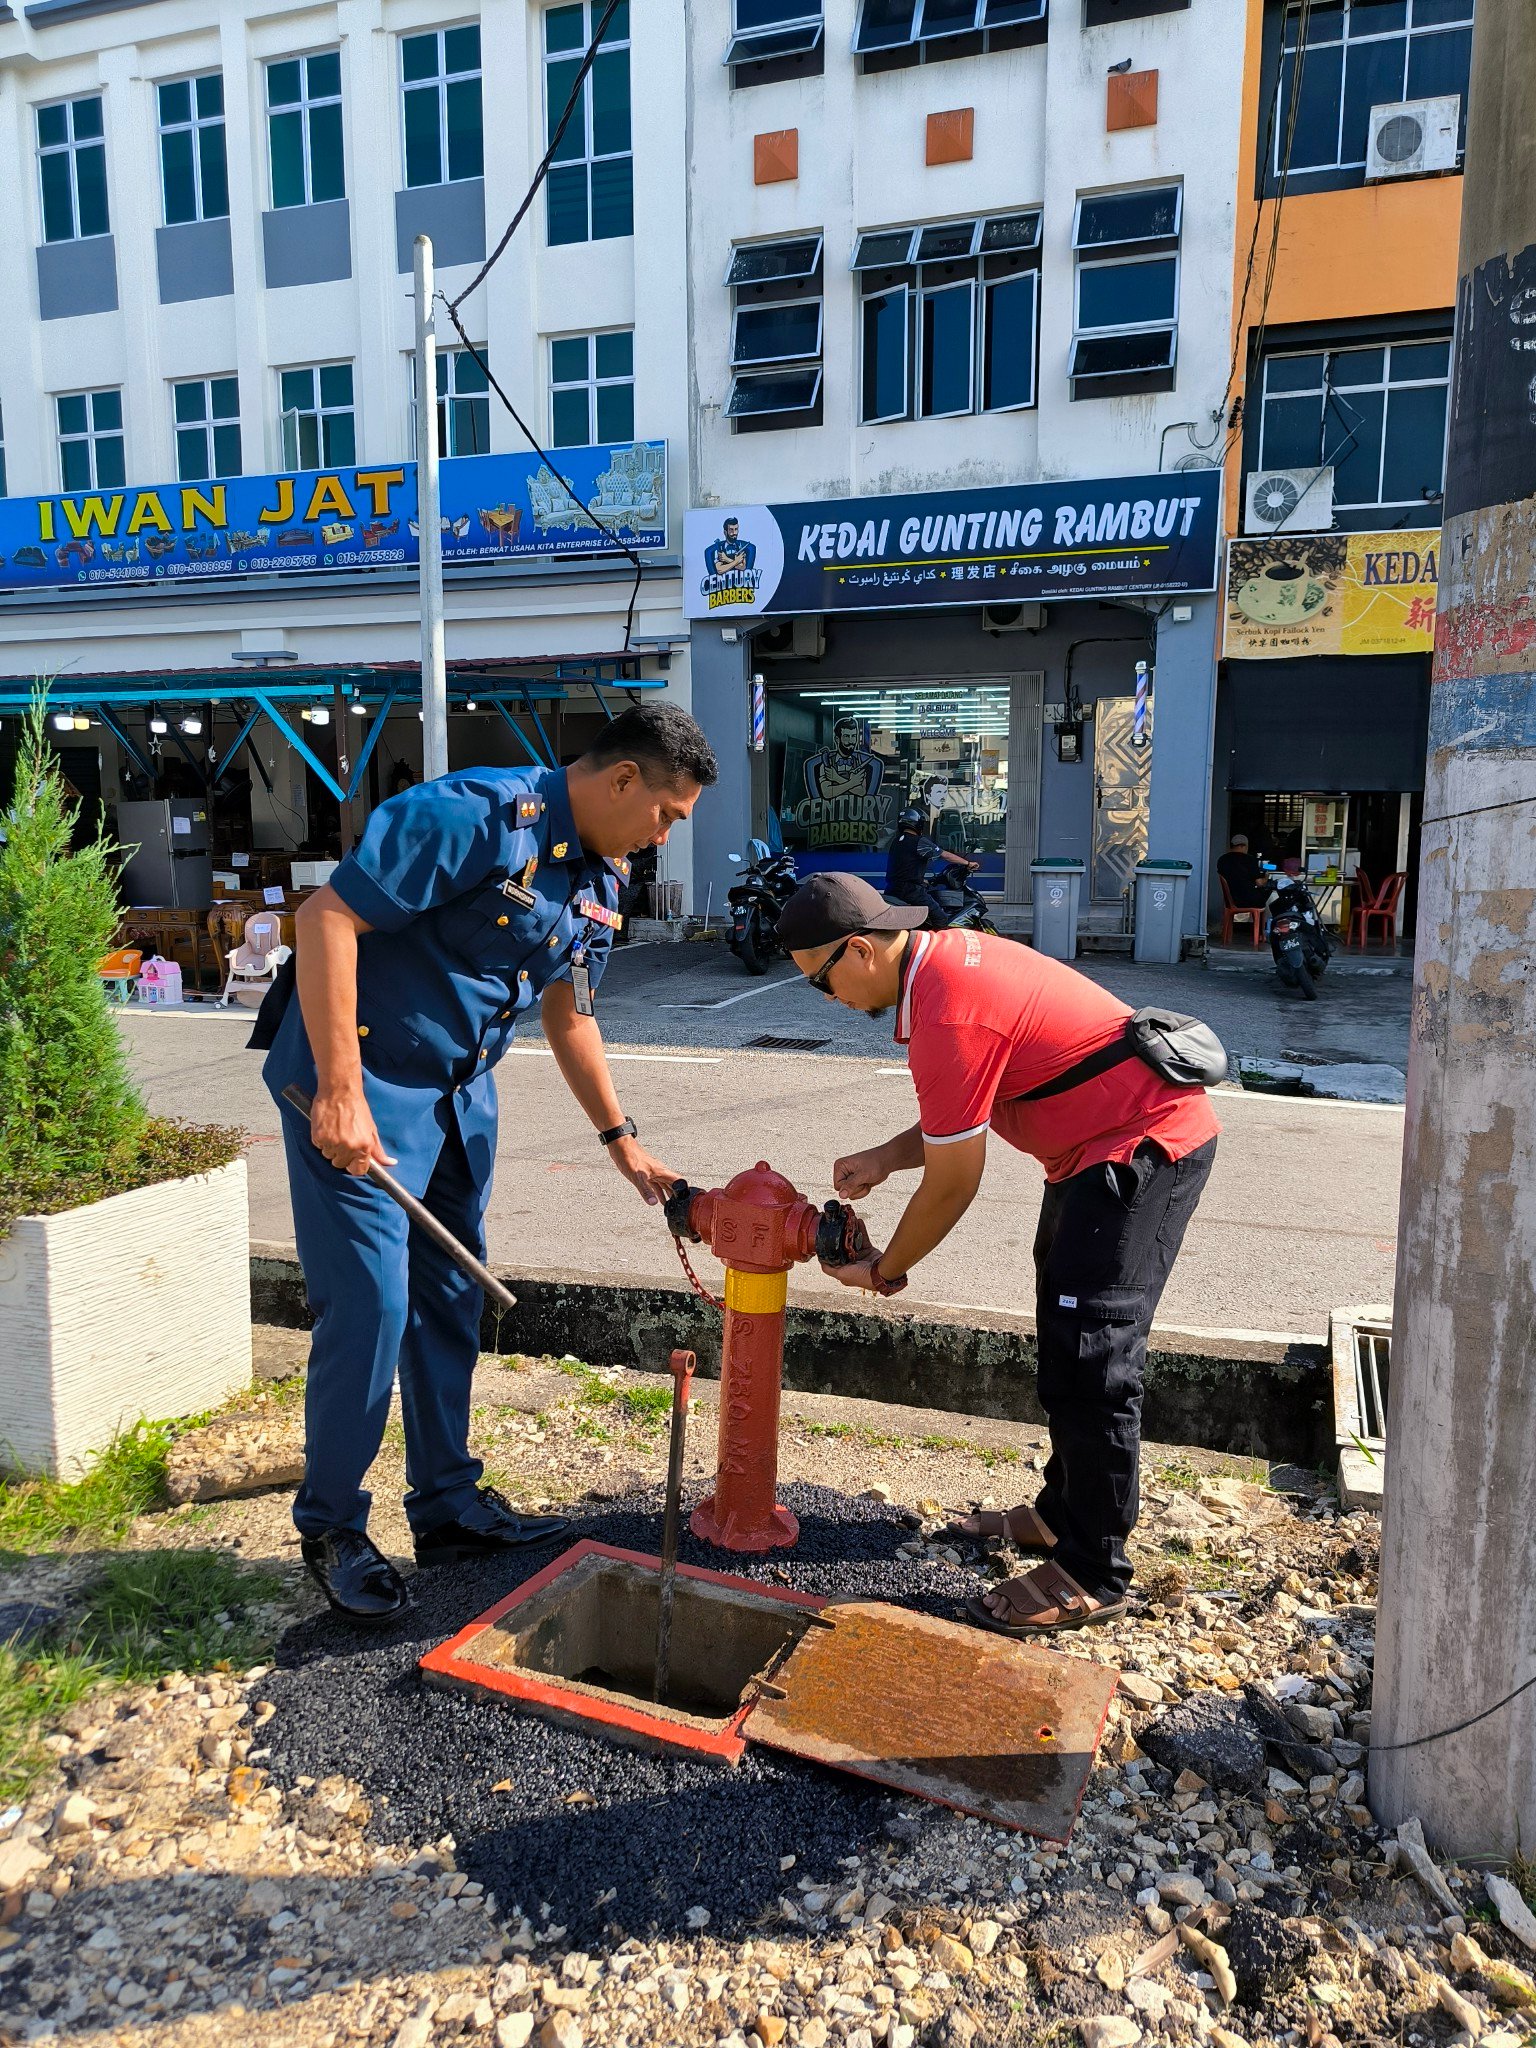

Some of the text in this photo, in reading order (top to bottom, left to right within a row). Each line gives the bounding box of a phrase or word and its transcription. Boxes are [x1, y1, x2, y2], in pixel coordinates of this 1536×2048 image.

[37, 468, 418, 543] IWAN JAT
[797, 497, 1202, 563] KEDAI GUNTING RAMBUT
[336, 548, 405, 565] 018-7755828
[456, 548, 478, 556] OLEH:
[479, 545, 509, 554] BERKAT
[511, 543, 535, 552] USAHA
[537, 542, 554, 550] KITA
[555, 539, 602, 550] ENTERPRISE
[167, 560, 232, 575] 010-5088895
[250, 554, 317, 570] 018-2205756
[1046, 562, 1087, 577] அழகு
[1091, 555, 1141, 571] மையம்
[1363, 550, 1439, 586] KEDA
[88, 566, 150, 580] 010-5441005
[701, 568, 763, 596] CENTURY
[951, 564, 997, 581] 理发店
[1107, 584, 1128, 592] RAMBUT
[709, 588, 755, 610] BARBERS
[1404, 596, 1437, 633] 新
[1236, 628, 1262, 636] Serbuk
[1263, 627, 1281, 636] Kopi
[920, 728, 956, 738] WELCOME
[797, 795, 891, 829] CENTURY
[810, 821, 878, 847] BARBERS
